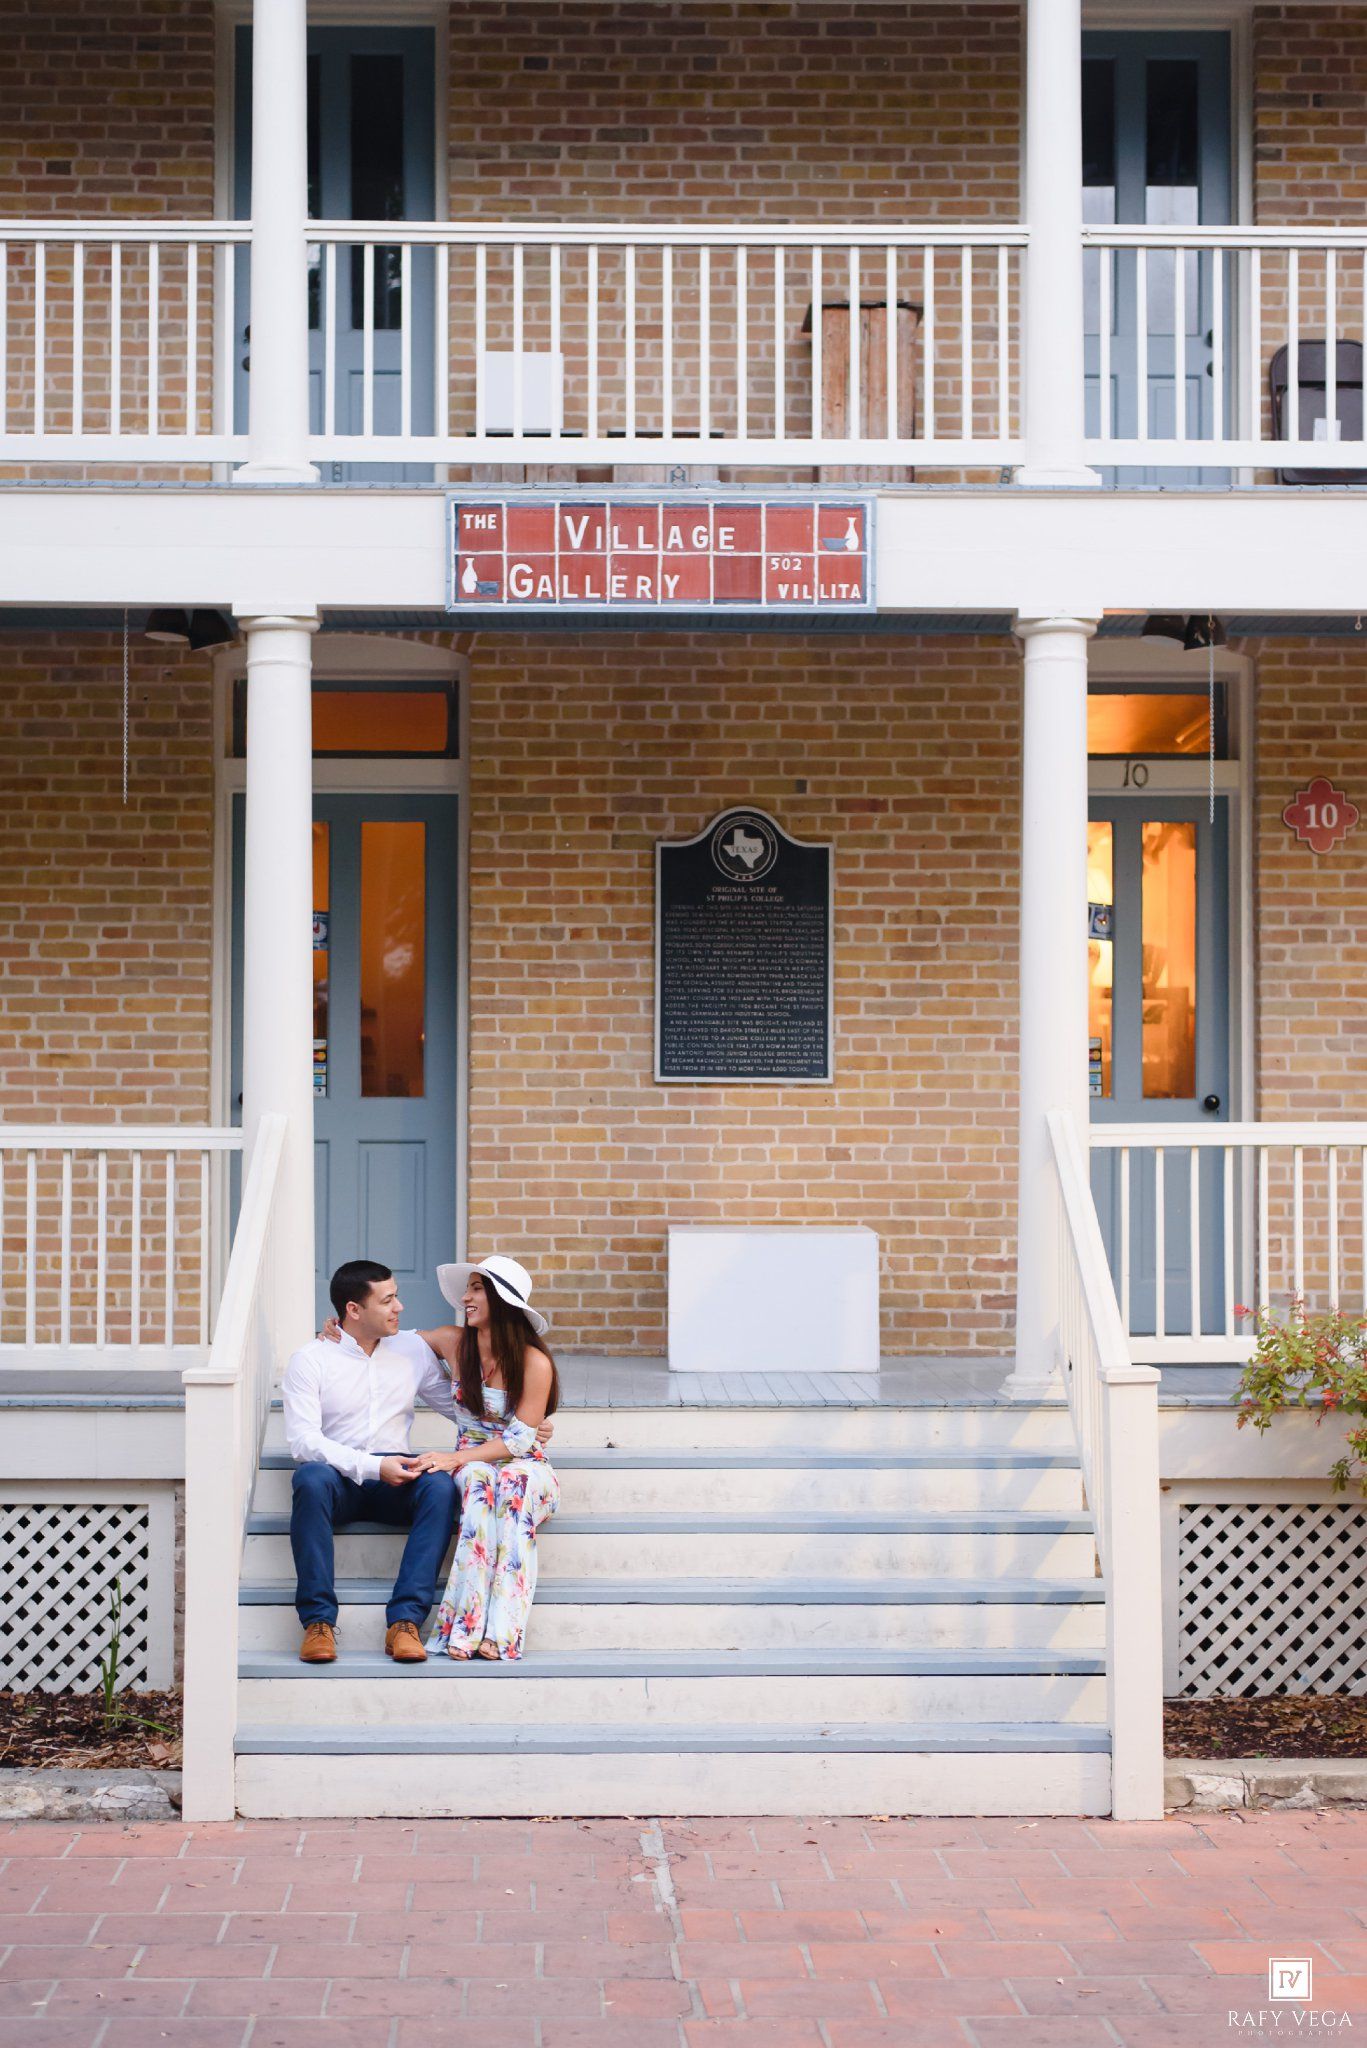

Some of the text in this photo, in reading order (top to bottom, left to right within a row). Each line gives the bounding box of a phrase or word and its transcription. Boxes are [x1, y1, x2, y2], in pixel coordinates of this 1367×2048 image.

[463, 514, 736, 550] THE VILLAGE
[771, 558, 802, 571] 502
[509, 563, 680, 600] GALLERY
[777, 583, 861, 600] VILLITA
[1122, 760, 1149, 788] 10
[1304, 803, 1338, 829] 10
